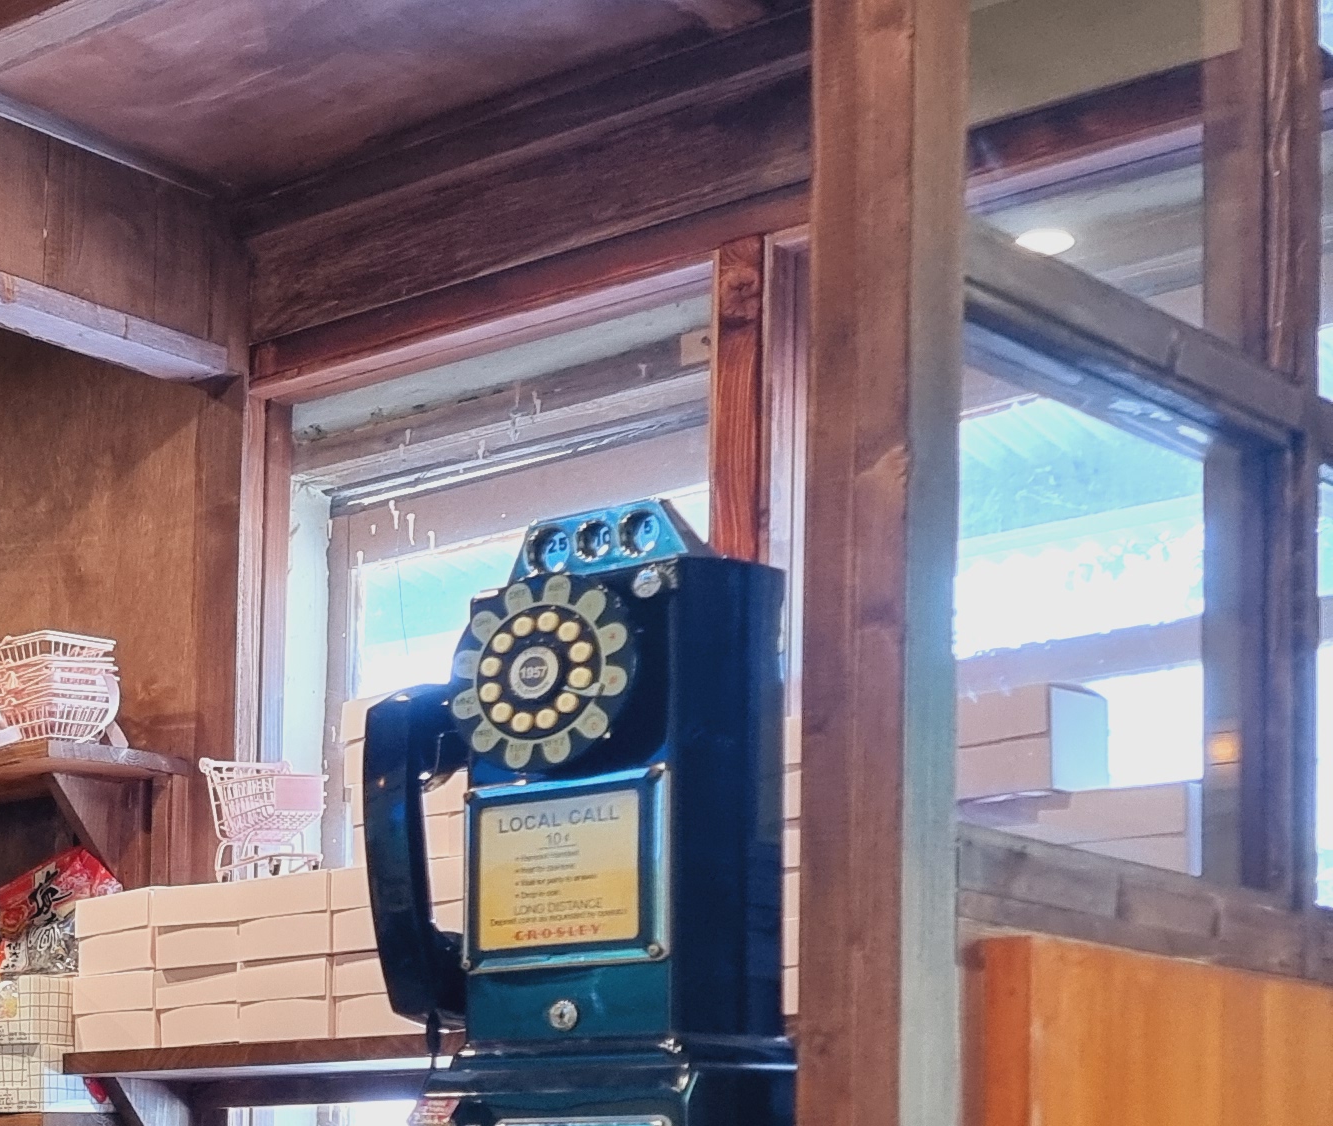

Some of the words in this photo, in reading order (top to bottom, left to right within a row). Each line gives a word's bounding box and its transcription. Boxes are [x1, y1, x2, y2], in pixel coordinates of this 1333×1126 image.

[643, 520, 653, 535] 5
[548, 537, 568, 553] 25
[519, 665, 549, 680] 1957
[498, 812, 562, 834] LOCAL
[568, 804, 620, 825] CALL
[514, 902, 546, 916] LONG
[547, 897, 603, 913] DISTANCE
[513, 924, 601, 941] CROSLEY
